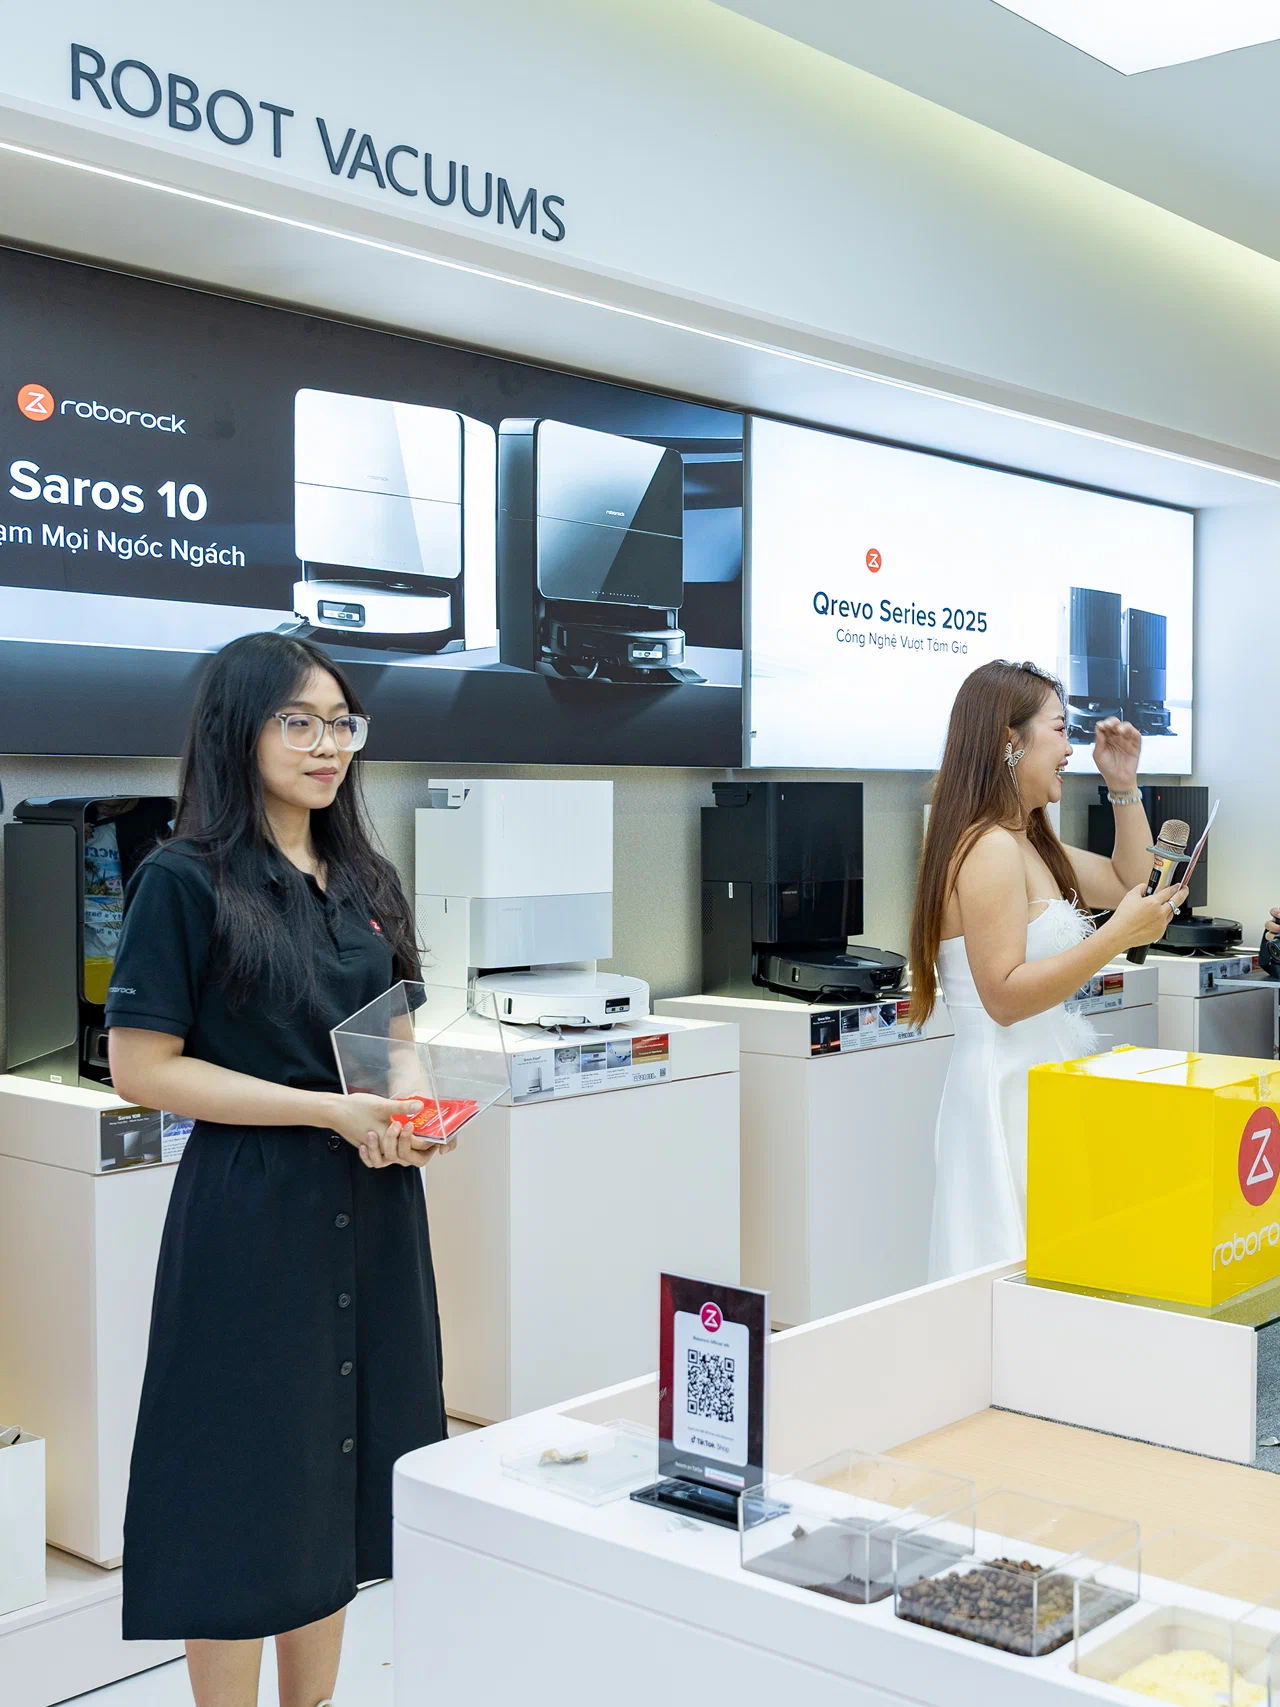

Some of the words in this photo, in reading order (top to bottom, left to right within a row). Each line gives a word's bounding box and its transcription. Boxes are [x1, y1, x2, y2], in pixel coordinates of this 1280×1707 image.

[71, 42, 294, 158] ROBOT
[315, 116, 566, 242] VACUUMS
[60, 400, 187, 434] roborock
[8, 459, 145, 514] Saros
[157, 480, 208, 521] 10
[42, 523, 88, 553] Mọi
[98, 529, 163, 560] Ngóc
[170, 537, 246, 568] Ngách
[812, 590, 874, 620] Qrevo
[879, 599, 936, 628] Series
[942, 607, 988, 633] 2025
[836, 628, 866, 648] Công
[868, 632, 898, 650] Nghệ
[951, 640, 968, 654] Giá
[696, 1437, 715, 1448] TikTok
[716, 1442, 731, 1455] Shop
